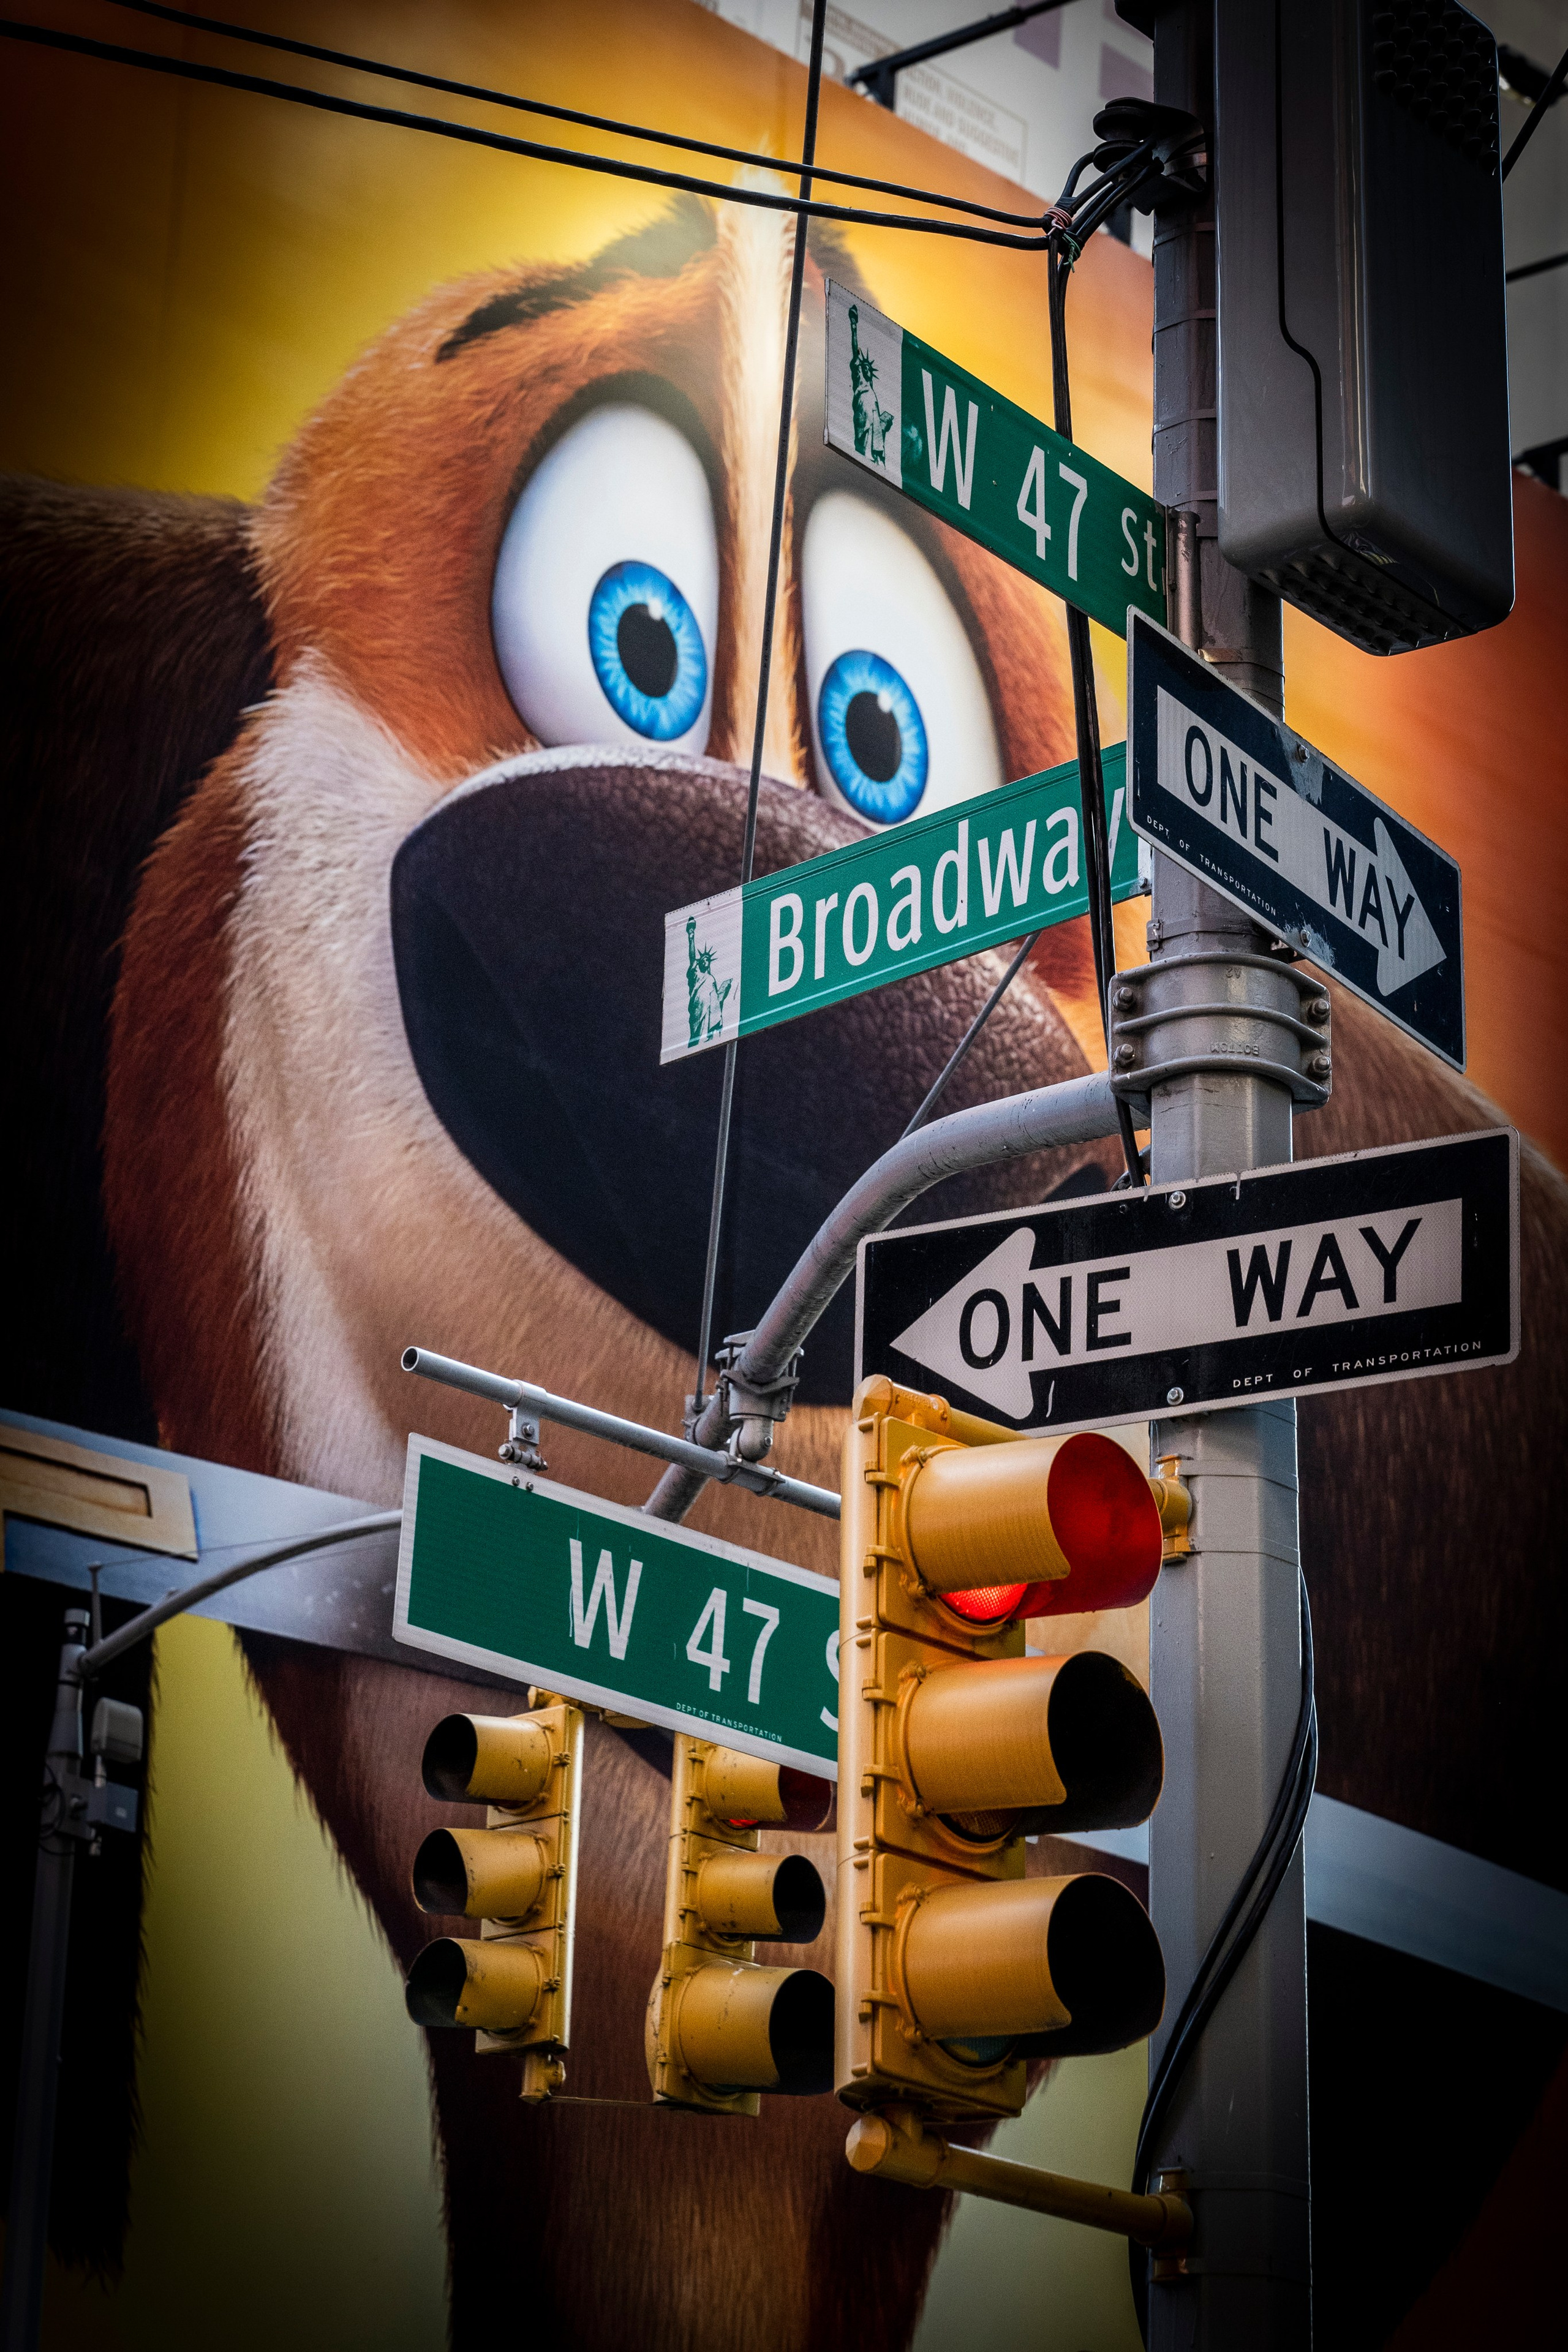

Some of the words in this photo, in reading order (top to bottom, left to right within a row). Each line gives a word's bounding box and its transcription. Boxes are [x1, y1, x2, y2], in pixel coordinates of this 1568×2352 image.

[922, 369, 979, 511] W
[1017, 445, 1088, 581] 47
[1121, 507, 1157, 592] St
[1180, 840, 1190, 851] OF
[1200, 854, 1276, 916] TRANSPORTATION
[1185, 725, 1279, 863] ONE
[1324, 826, 1415, 960] WAY
[959, 1266, 1131, 1370] ONE
[1226, 1218, 1422, 1327] WAY
[1233, 1374, 1273, 1388] DEPT
[1293, 1368, 1313, 1378] OF
[1332, 1341, 1482, 1372] TRANSPORTATION
[570, 1538, 643, 1661] W
[685, 1587, 780, 1705] 47
[676, 1702, 696, 1715] DEPT
[699, 1710, 709, 1719] OF
[712, 1713, 782, 1743] TRANSPORTATION
